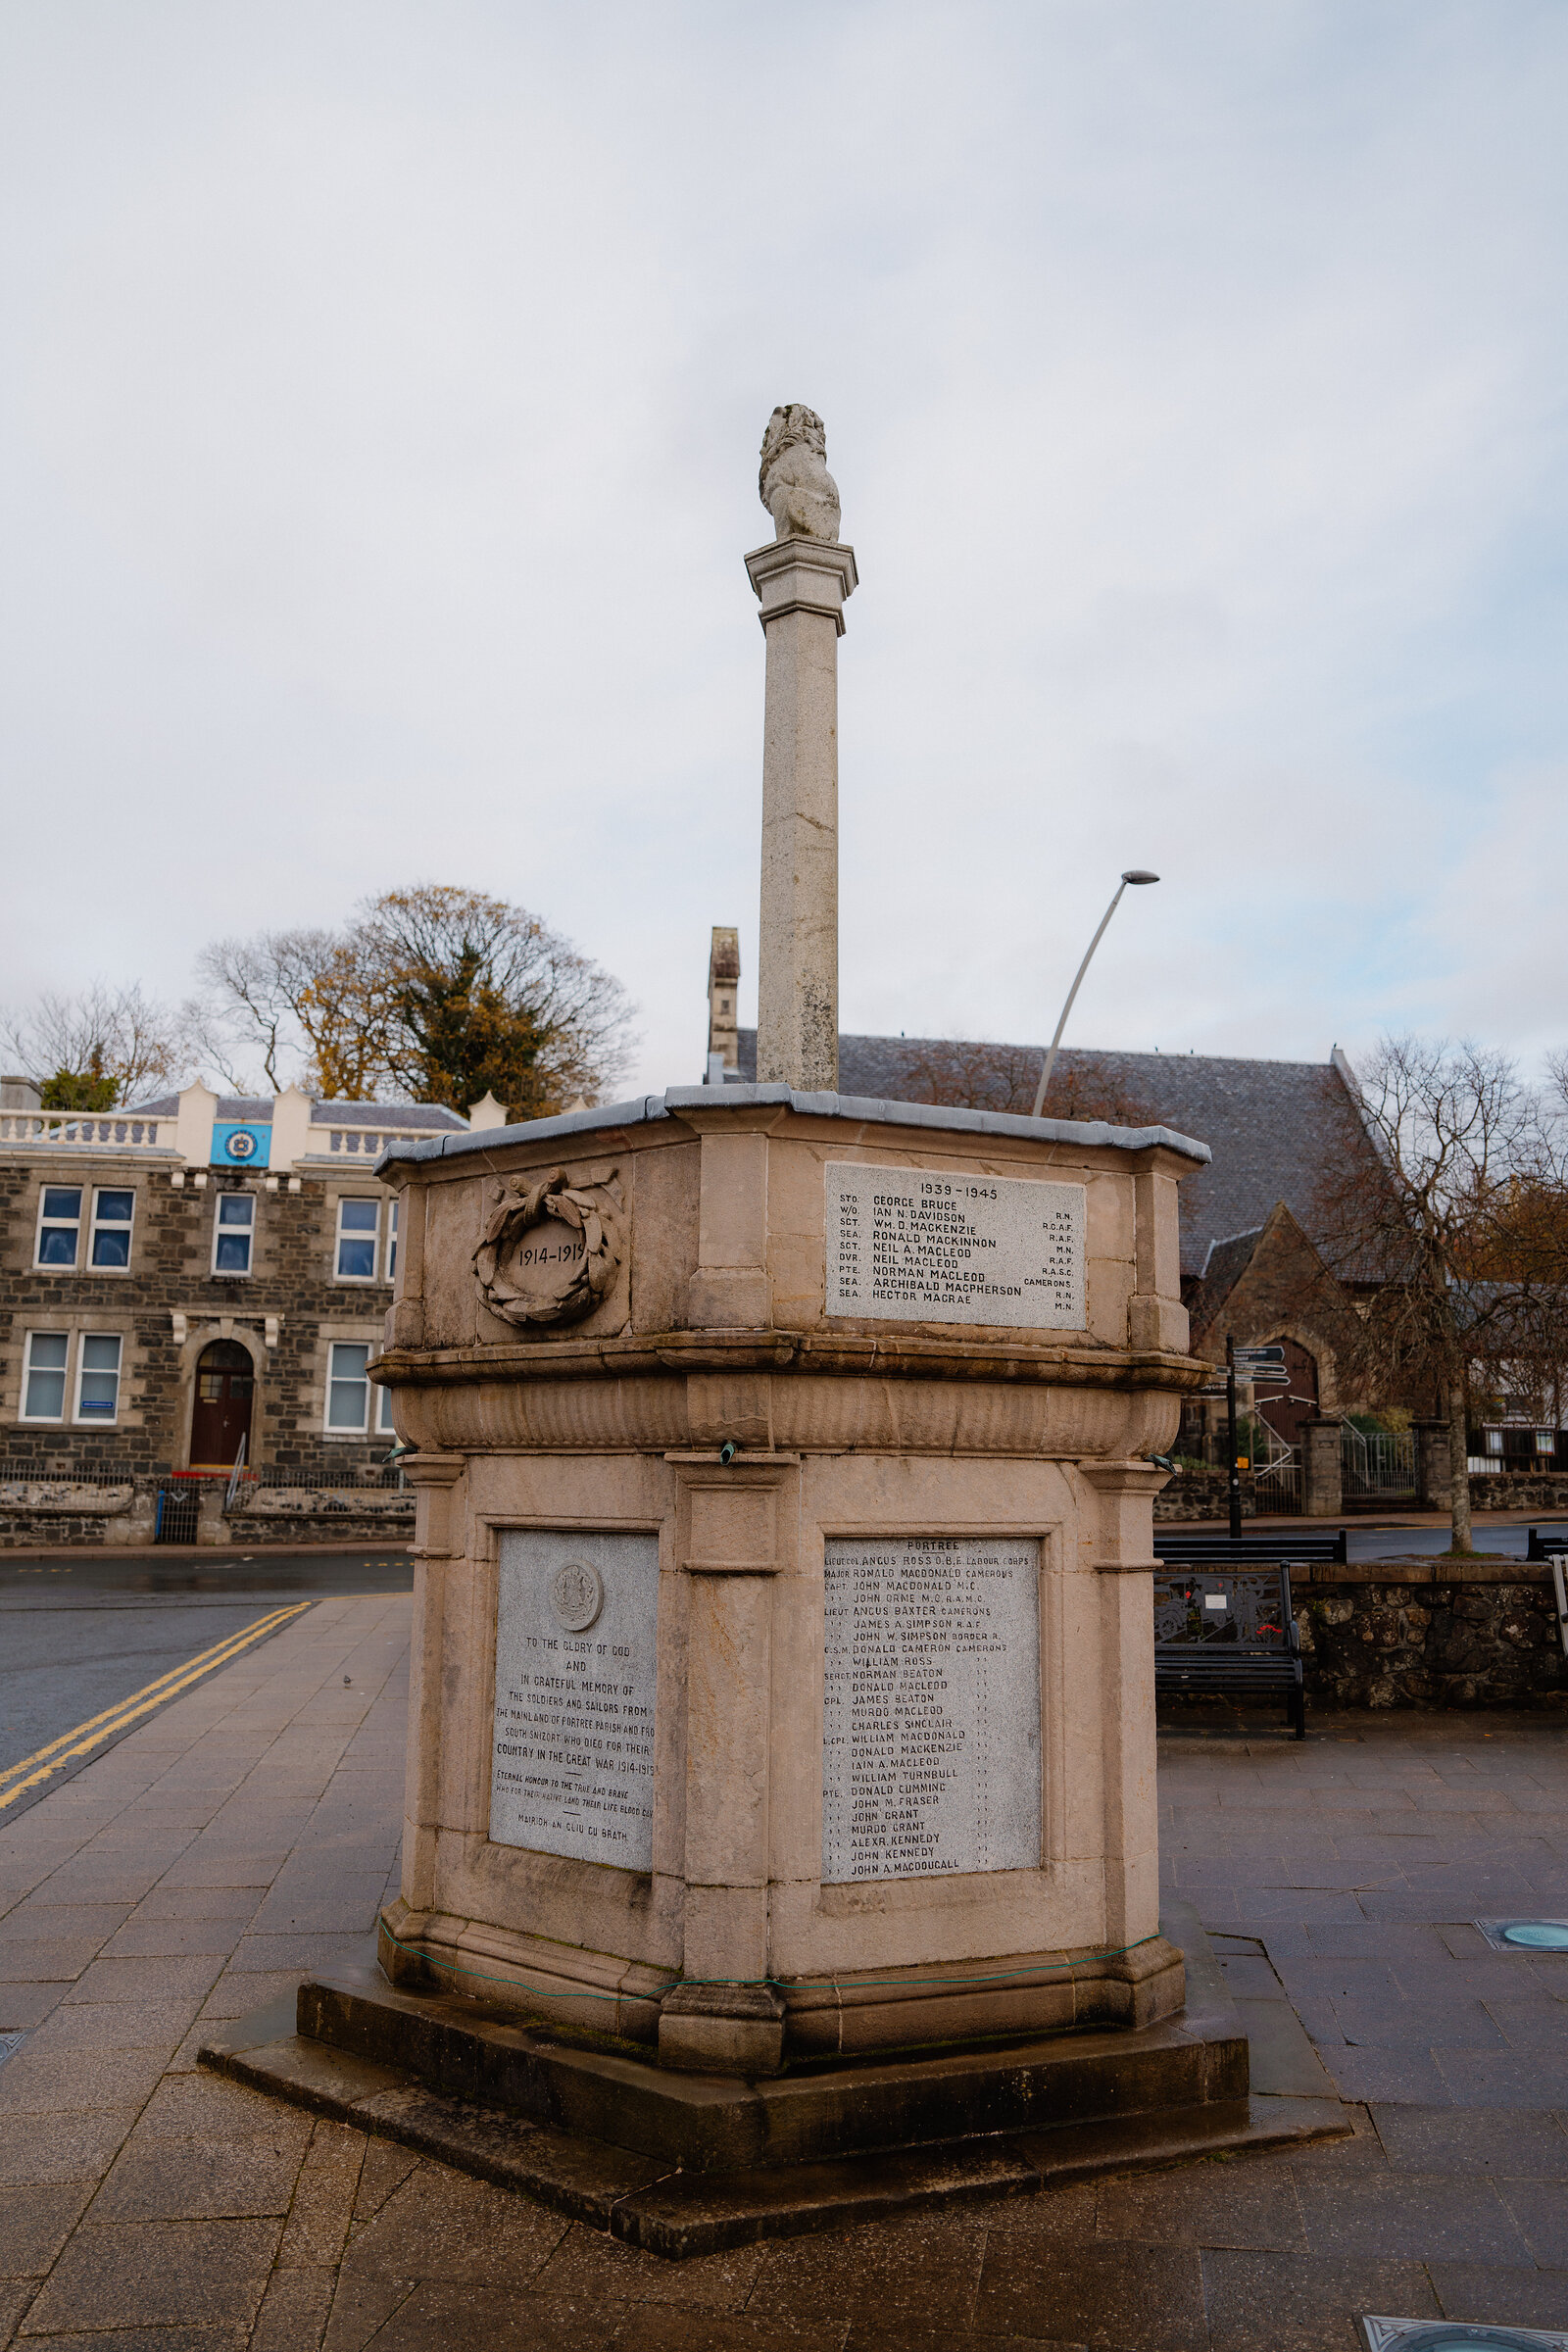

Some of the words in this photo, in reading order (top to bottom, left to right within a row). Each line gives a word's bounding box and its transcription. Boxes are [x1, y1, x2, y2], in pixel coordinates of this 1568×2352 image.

[840, 1195, 859, 1203] STO.
[873, 1196, 914, 1207] GEORGE
[921, 1200, 956, 1211] BRUCE
[1056, 1212, 1073, 1221] R.N.
[840, 1205, 859, 1215] W/O.
[873, 1206, 894, 1217] IAN
[911, 1209, 965, 1223] DAVIDSON
[910, 1222, 976, 1235] MACKENZIE
[1050, 1234, 1074, 1243] R.A.F.
[873, 1231, 920, 1244] RONALD
[927, 1235, 997, 1249] MACKINNON
[873, 1243, 899, 1252] NEIL
[918, 1246, 971, 1258] MACLEOD
[1050, 1256, 1073, 1265] R.A.F.
[839, 1253, 861, 1262] DVR.
[873, 1254, 899, 1265] NEIL
[906, 1256, 958, 1268] MACLEOD
[1042, 1267, 1074, 1276] R.A.S.C.
[839, 1265, 859, 1274] PTE.
[873, 1266, 924, 1278] NORMAN
[931, 1270, 985, 1282] MACLEOD
[839, 1277, 861, 1286] SEA.
[873, 1278, 940, 1291] ARCHIBALD
[946, 1282, 1021, 1297] MACPHERSON
[1055, 1291, 1074, 1299] R.N.
[839, 1289, 861, 1298] SEA.
[873, 1290, 916, 1301] HECTOR
[923, 1293, 971, 1304] MACRAE
[907, 1542, 959, 1550] PORTREE
[853, 1569, 895, 1578] RONALD
[901, 1569, 961, 1578] MACDONALD
[853, 1582, 880, 1591] JOHN
[887, 1582, 952, 1591] MACDONALD
[853, 1594, 880, 1603] JOHN
[887, 1594, 914, 1603] ORME
[895, 1606, 936, 1615] BAXTER
[853, 1620, 890, 1629] JAMES
[906, 1620, 952, 1629] SIMPSON
[853, 1632, 880, 1641] JOHN
[901, 1632, 947, 1641] SIMPSON
[526, 1638, 537, 1647] TO
[543, 1639, 559, 1649] THE
[597, 1644, 607, 1654] OF
[853, 1644, 896, 1654] DONALD
[902, 1644, 951, 1653] CAMERON
[566, 1661, 586, 1671] AND
[853, 1657, 899, 1667] WILLIAM
[904, 1657, 932, 1666] ROSS
[853, 1670, 897, 1680] NORMAN
[903, 1669, 943, 1679] BEATON
[521, 1674, 529, 1685] IN
[582, 1681, 617, 1694] MEMORY
[623, 1686, 634, 1695] OF
[853, 1683, 894, 1692] DONALD
[900, 1681, 948, 1690] MACLEOD
[510, 1691, 523, 1701] THE
[527, 1694, 563, 1706] SOLDIERS
[566, 1699, 581, 1709] AND
[586, 1701, 618, 1713] SAILORS
[623, 1706, 647, 1717] FROM
[853, 1695, 889, 1704] JAMES
[895, 1693, 934, 1703] BEATON
[852, 1707, 889, 1716] MURDO
[895, 1706, 943, 1715] MACLEOD
[497, 1708, 508, 1718] THE
[511, 1710, 548, 1723] MAINLAND
[562, 1717, 592, 1729] PORTREE
[596, 1721, 621, 1734] PARISH
[624, 1725, 638, 1736] AND
[852, 1721, 899, 1731] CHARLES
[905, 1719, 953, 1729] SINCLAIR
[505, 1727, 527, 1739] SOUTH
[529, 1731, 560, 1742] SNIZORT
[564, 1736, 581, 1745] WHO
[584, 1738, 602, 1749] DIED
[607, 1740, 622, 1752] FOR
[626, 1743, 650, 1755] THEIR
[852, 1734, 894, 1743] WILLIAM
[901, 1731, 965, 1741] MACDONALD
[852, 1747, 894, 1757] DONALD
[901, 1742, 963, 1754] MACKENZIE
[497, 1743, 533, 1758] COUNTRY
[538, 1749, 546, 1760] IN
[549, 1750, 563, 1763] THE
[596, 1758, 614, 1770] WAR
[852, 1760, 874, 1770] IAIN
[891, 1756, 940, 1768] MACLEOD
[852, 1773, 897, 1783] WILLIAM
[903, 1769, 957, 1780] TURNBULL
[497, 1770, 522, 1782] ETERNAL
[525, 1776, 549, 1786] HONOUR
[561, 1782, 572, 1790] THE
[575, 1784, 590, 1793] TRUE
[592, 1787, 606, 1795] AND
[609, 1789, 629, 1799] BRAVE
[823, 1789, 843, 1798] PTE.
[851, 1786, 893, 1796] DONALD
[564, 1796, 579, 1805] LAND
[583, 1799, 601, 1809] THEIR
[604, 1803, 617, 1812] LIFE
[620, 1805, 640, 1816] BLOOD
[852, 1799, 879, 1809] JOHN
[899, 1796, 939, 1806] FRASER
[852, 1812, 877, 1822] JOHN
[602, 1829, 627, 1840] BRATH
[852, 1825, 887, 1835] MURDO
[851, 1838, 890, 1847] ALEXR.
[891, 1834, 940, 1845] KENNEDY
[852, 1851, 879, 1861] JOHN
[885, 1847, 934, 1859] KENNEDY
[852, 1865, 879, 1876] JOHN
[893, 1859, 959, 1872] MACDOUGALL
